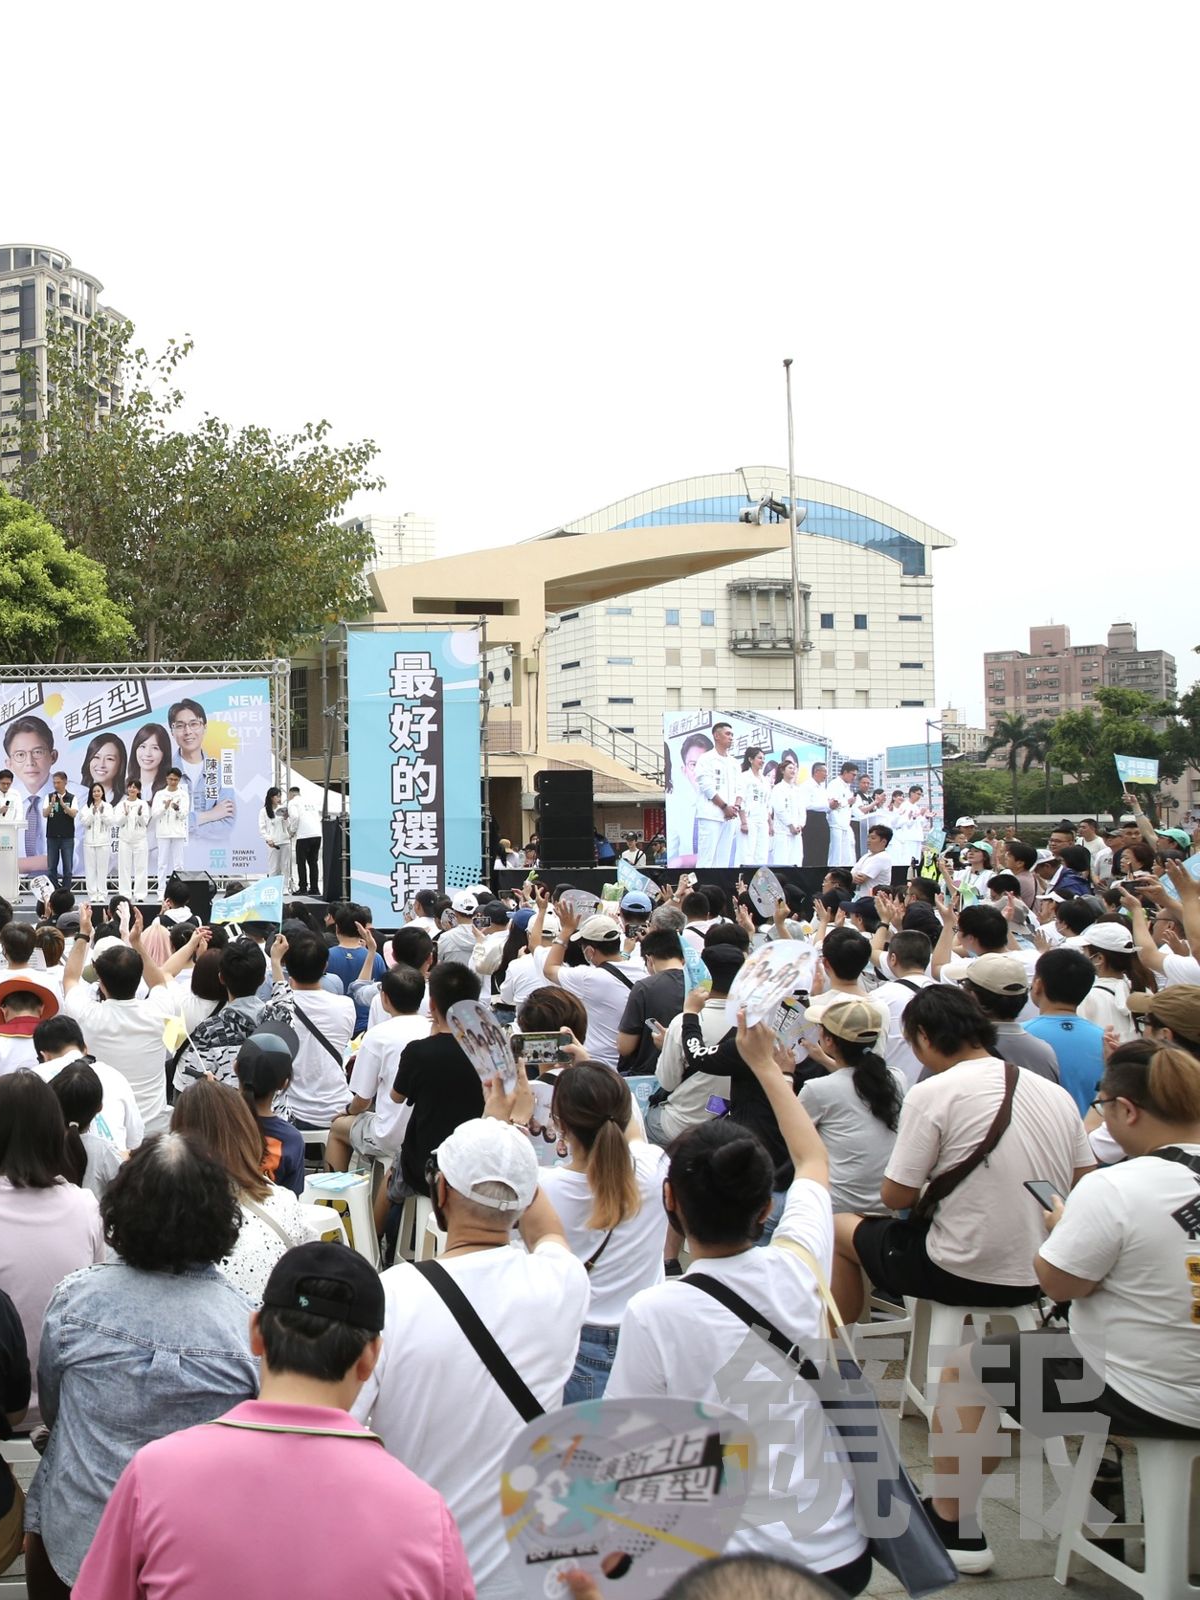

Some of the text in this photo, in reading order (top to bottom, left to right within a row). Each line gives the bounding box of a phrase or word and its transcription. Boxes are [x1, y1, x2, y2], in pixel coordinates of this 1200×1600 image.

[228, 695, 263, 706] NEW
[64, 680, 145, 737] 更有型
[213, 711, 263, 721] TAIPEI
[227, 727, 263, 738] CITY
[389, 652, 440, 913] 最好的選擇
